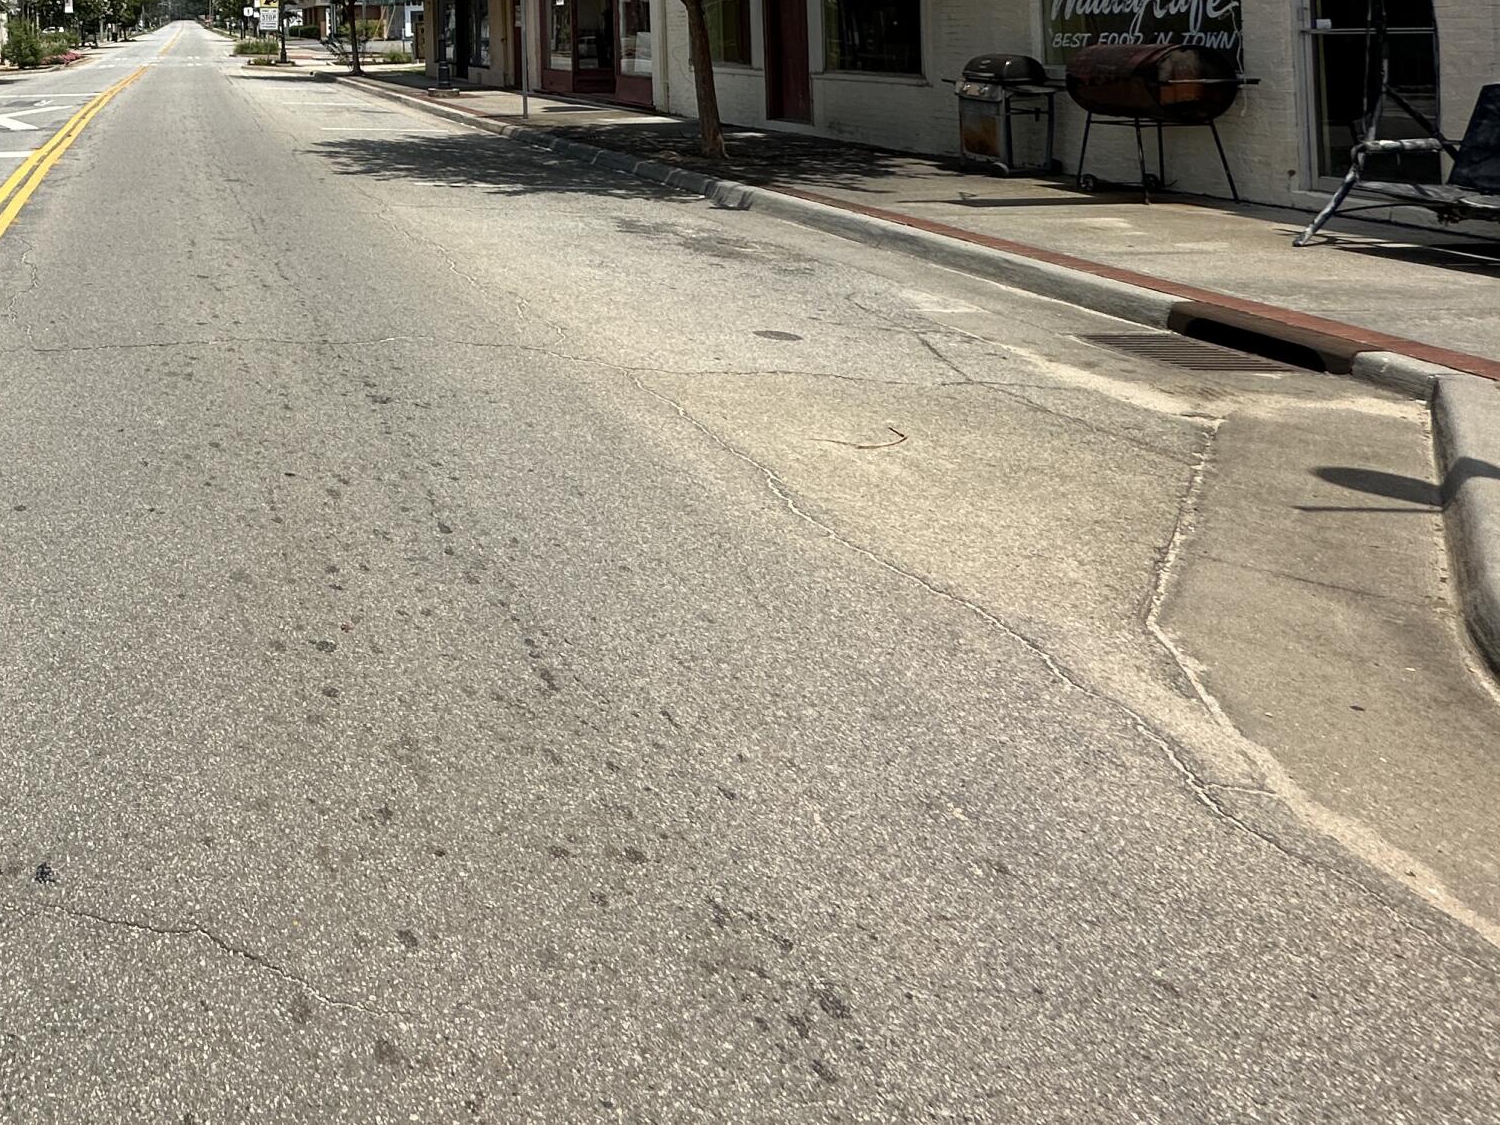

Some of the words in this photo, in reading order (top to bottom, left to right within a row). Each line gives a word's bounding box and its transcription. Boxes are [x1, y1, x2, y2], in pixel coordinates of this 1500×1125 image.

[1052, 32, 1093, 48] BEST
[1097, 31, 1144, 45] FOOD
[1180, 31, 1237, 49] TOWN
